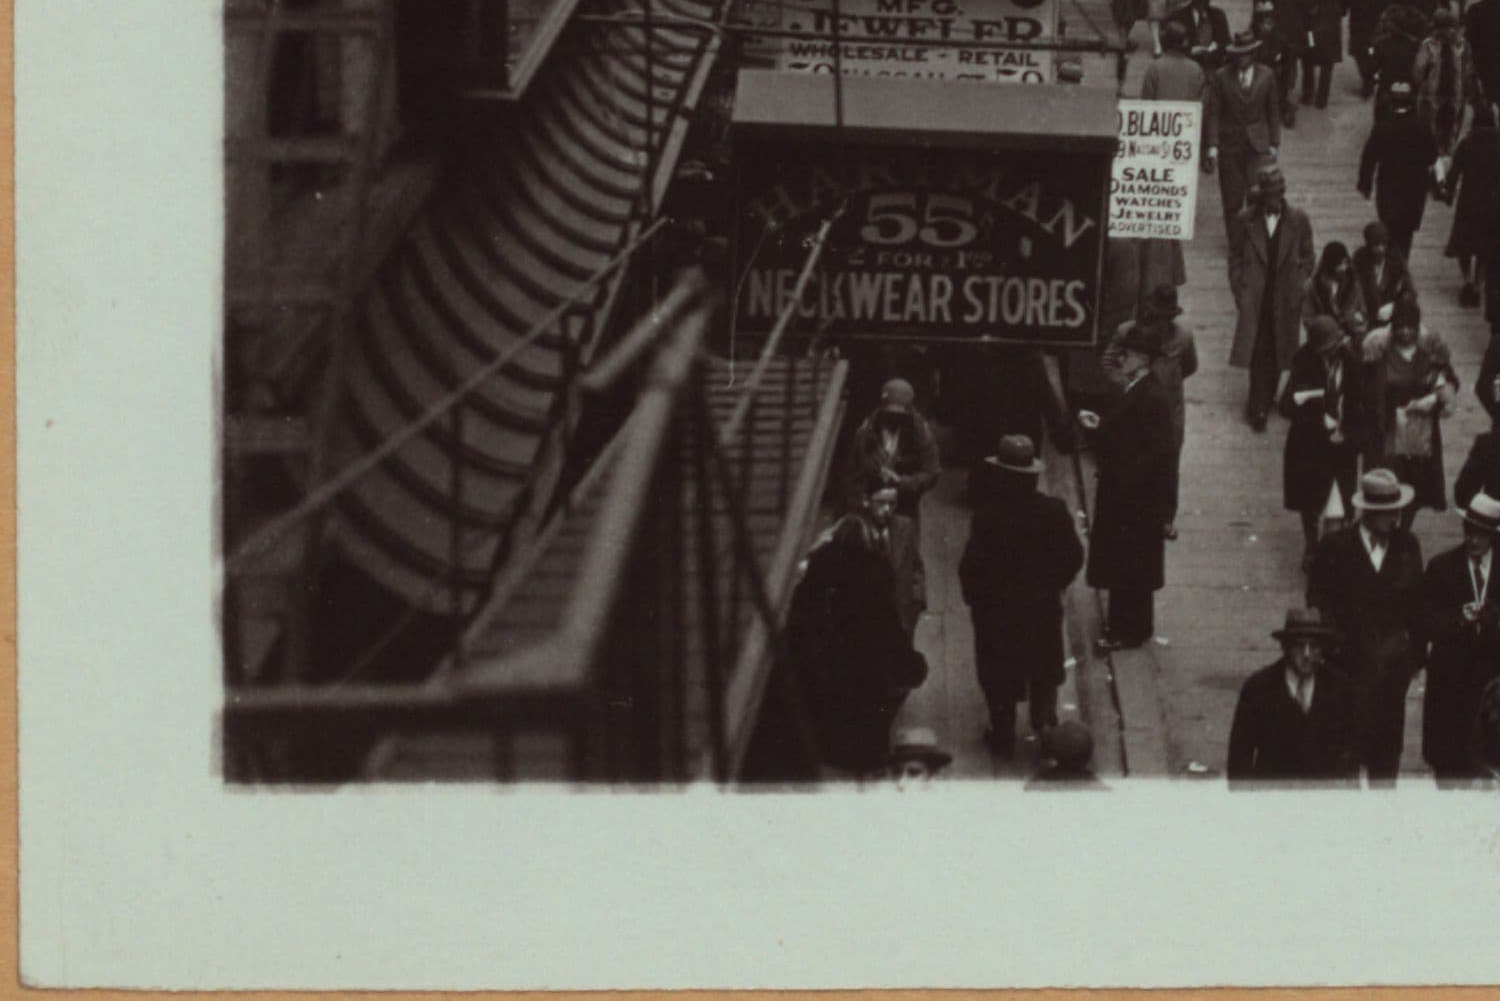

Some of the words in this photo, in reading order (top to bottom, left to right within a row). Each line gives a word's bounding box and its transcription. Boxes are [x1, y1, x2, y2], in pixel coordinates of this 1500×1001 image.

[789, 43, 928, 61] WHOLESALE
[958, 50, 1039, 67] RETAIL
[1173, 141, 1192, 160] 63
[1121, 167, 1175, 183] SALE
[1110, 178, 1188, 197] DIAMONDS
[1115, 197, 1182, 208] WATCHES
[1110, 207, 1181, 221] JEWELRY
[1109, 221, 1182, 236] ADVERTISED
[876, 250, 934, 268] FOR
[748, 267, 954, 324] NECKWEAR
[963, 274, 1086, 327] STORES
